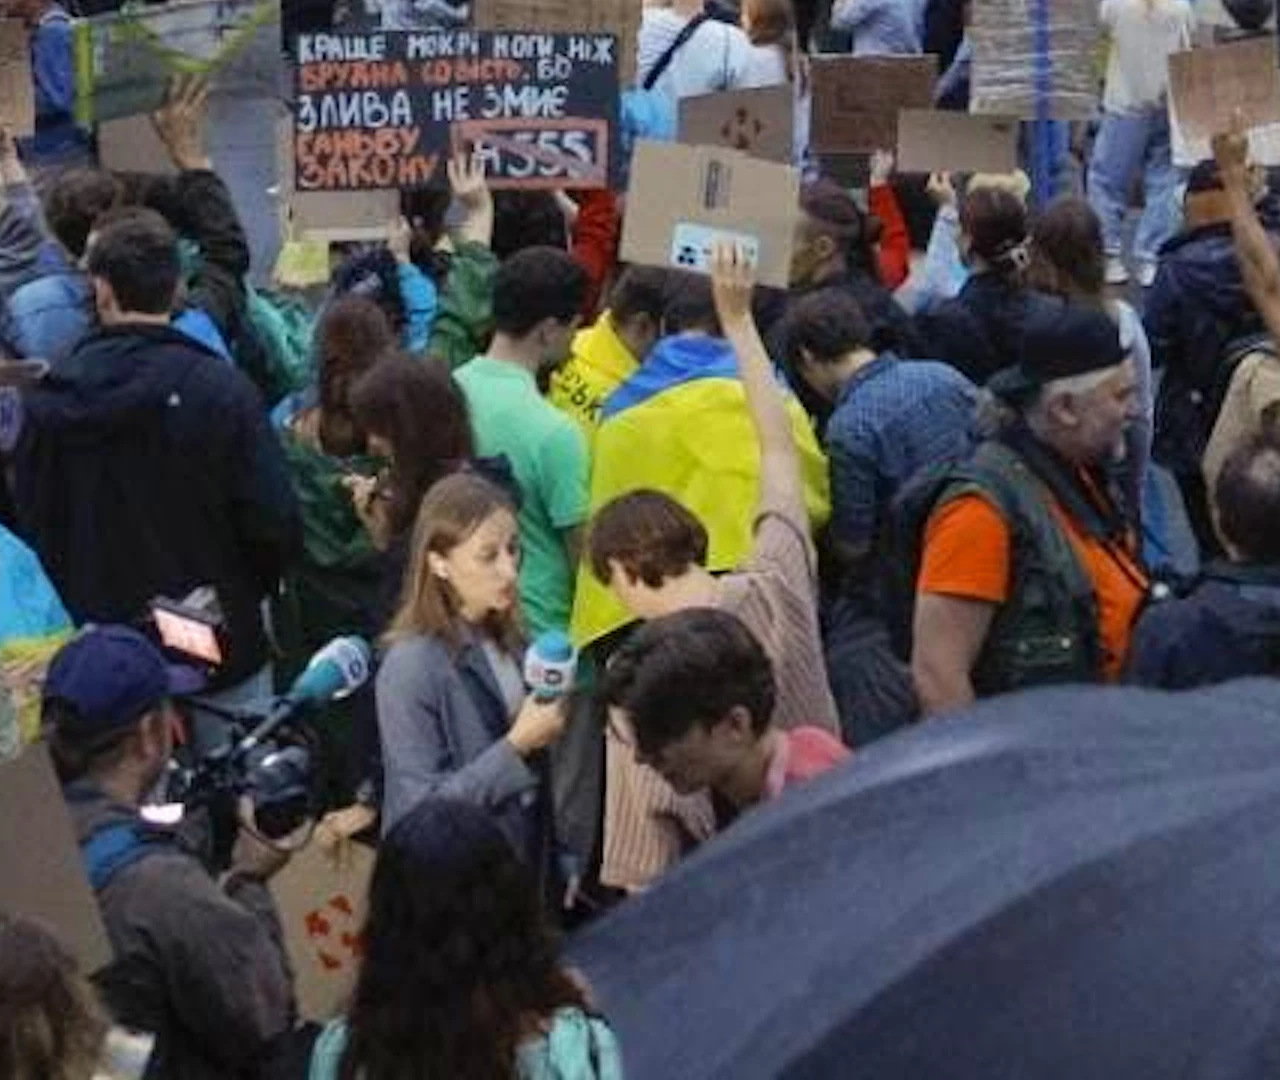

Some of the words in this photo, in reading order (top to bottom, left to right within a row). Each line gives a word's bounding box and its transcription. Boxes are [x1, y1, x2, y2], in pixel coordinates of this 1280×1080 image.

[297, 33, 387, 64] КРАЩЕ
[407, 31, 478, 60] МОКРІ
[569, 36, 615, 64] НІЖ
[300, 60, 407, 92] БРУДНА
[536, 53, 572, 80] БО
[297, 88, 412, 132] ЗЛИВА
[433, 86, 469, 121] НЕ
[481, 82, 568, 118] ЗМИЄ
[296, 125, 420, 159] ГАНЬБУ
[297, 152, 440, 189] ЗАКОНУ
